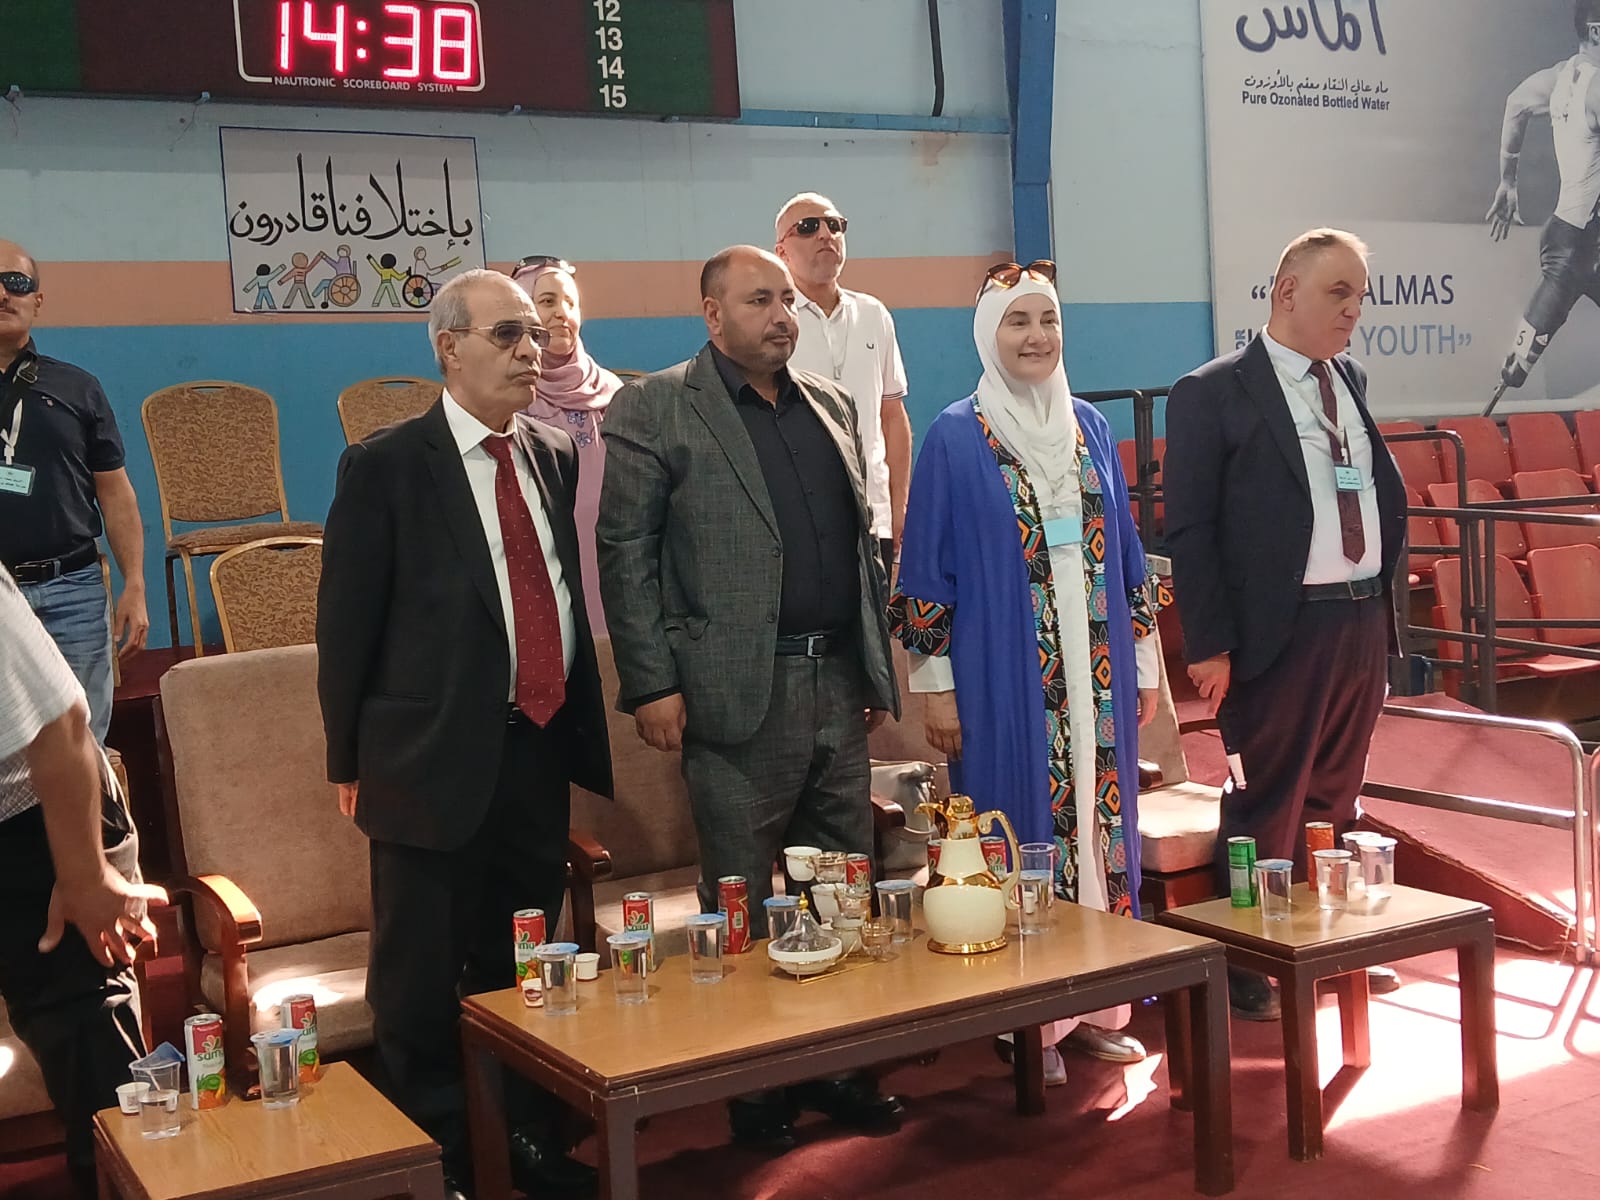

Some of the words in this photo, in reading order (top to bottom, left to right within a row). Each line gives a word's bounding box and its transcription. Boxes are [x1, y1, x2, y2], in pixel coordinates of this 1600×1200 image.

[593, 0, 622, 22] 12
[278, 0, 473, 80] 14:38
[595, 26, 623, 51] 13
[597, 55, 625, 79] 14
[274, 76, 337, 88] NAUTRONIC
[343, 78, 411, 91] SCOREBOARD
[417, 83, 454, 93] SYSTEM
[599, 84, 627, 108] 15
[1242, 91, 1267, 105] Pure
[1270, 92, 1320, 107] Ozonated
[1322, 95, 1359, 109] Bottled
[1361, 97, 1390, 111] Water
[229, 152, 330, 246] قادرون
